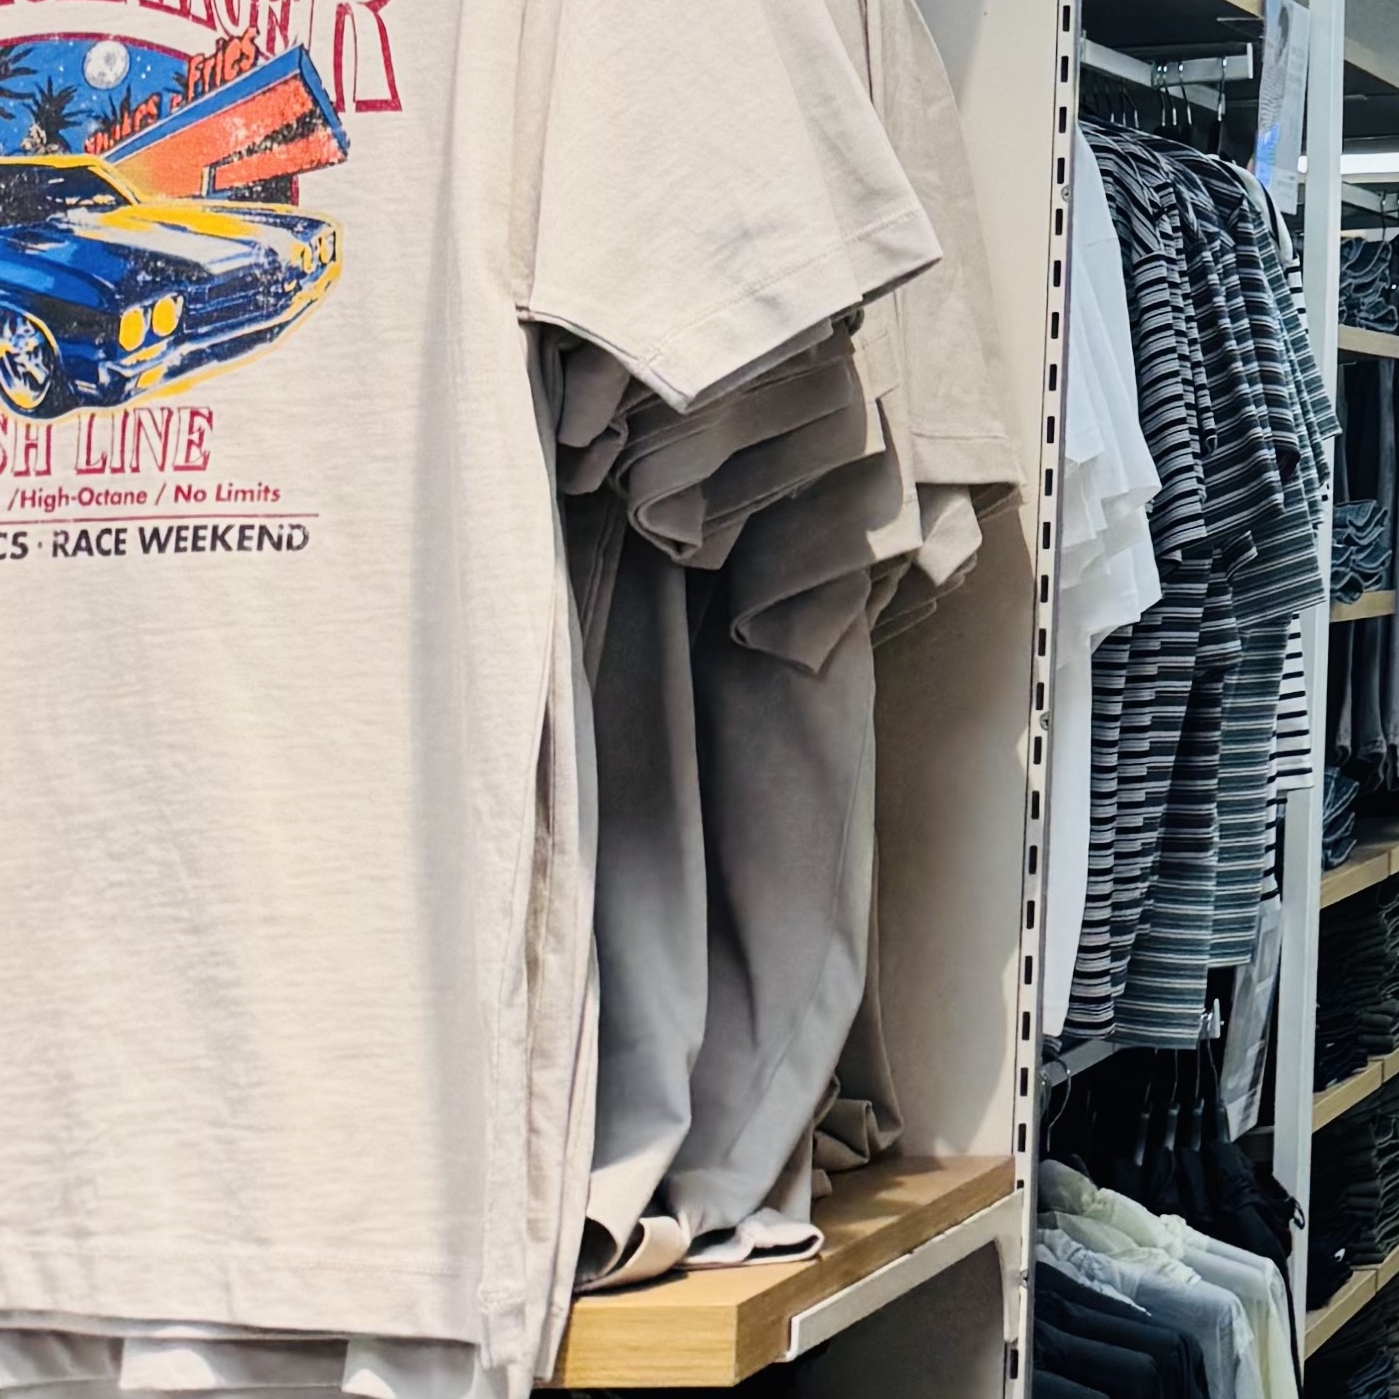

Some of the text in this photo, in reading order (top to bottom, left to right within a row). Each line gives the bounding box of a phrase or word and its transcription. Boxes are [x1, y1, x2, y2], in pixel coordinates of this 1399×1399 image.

[75, 406, 214, 475] LINE
[173, 484, 207, 504] No
[215, 482, 282, 504] Limits
[52, 527, 128, 558] RACE
[138, 523, 310, 554] WEEKEND
